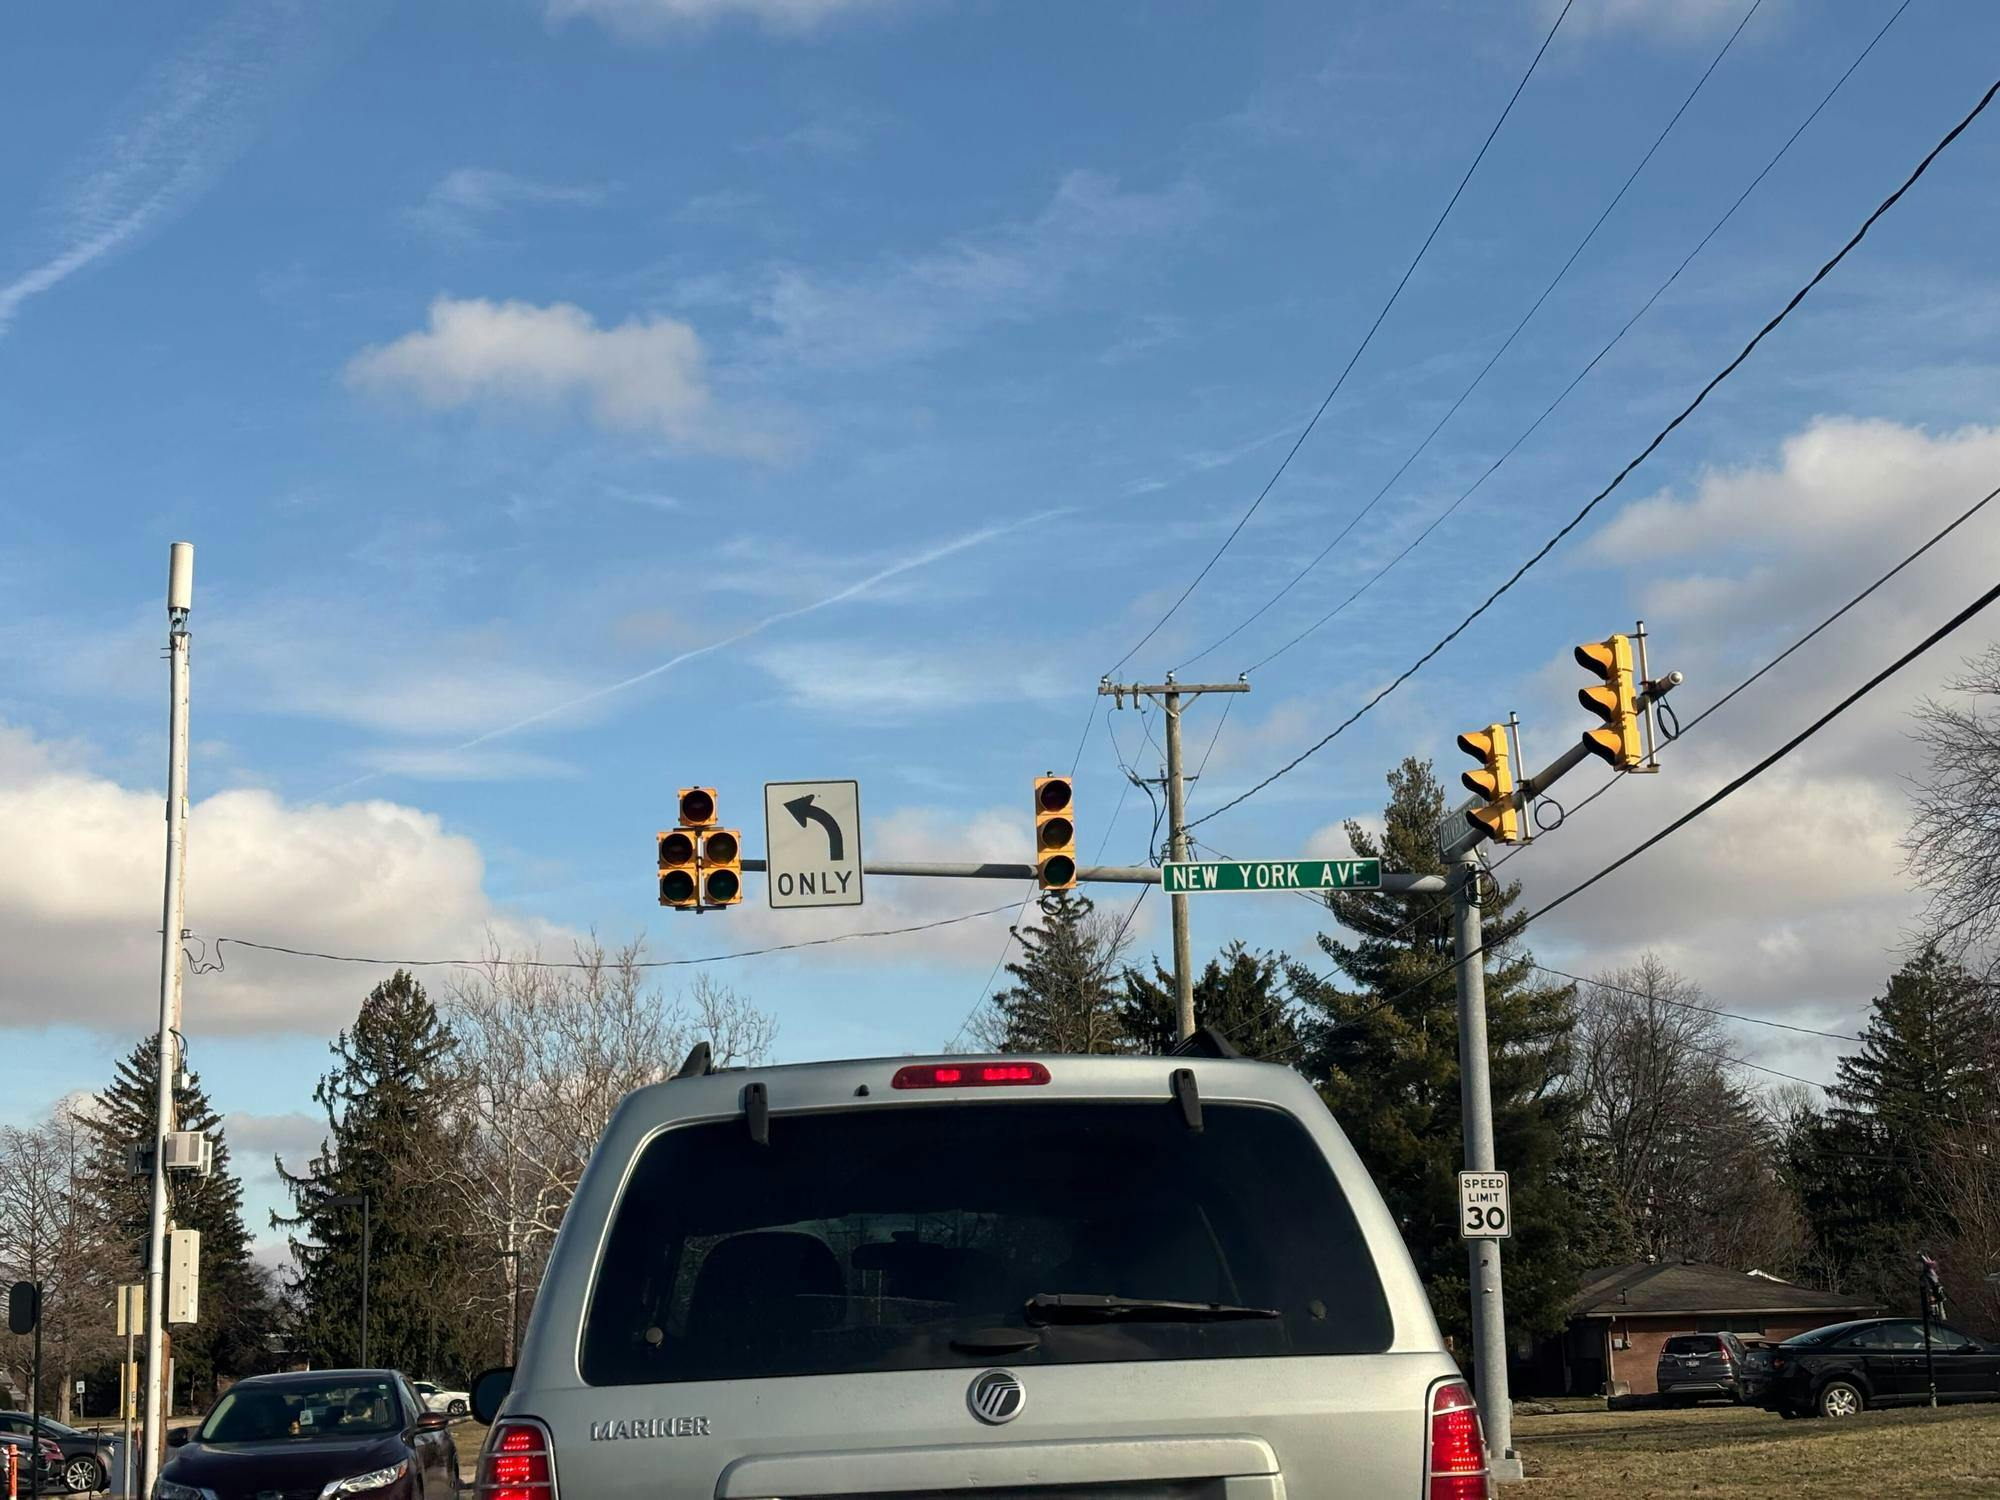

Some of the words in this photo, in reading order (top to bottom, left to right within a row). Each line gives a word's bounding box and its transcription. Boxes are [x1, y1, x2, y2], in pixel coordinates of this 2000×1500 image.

[778, 871, 852, 896] ONLY
[1173, 866, 1218, 889] NEW
[1239, 864, 1300, 887] YORK
[1464, 1179, 1504, 1189] SPEED
[1469, 1193, 1499, 1202] LIMIT
[1466, 1206, 1505, 1230] 30
[590, 1416, 711, 1441] MARINER
